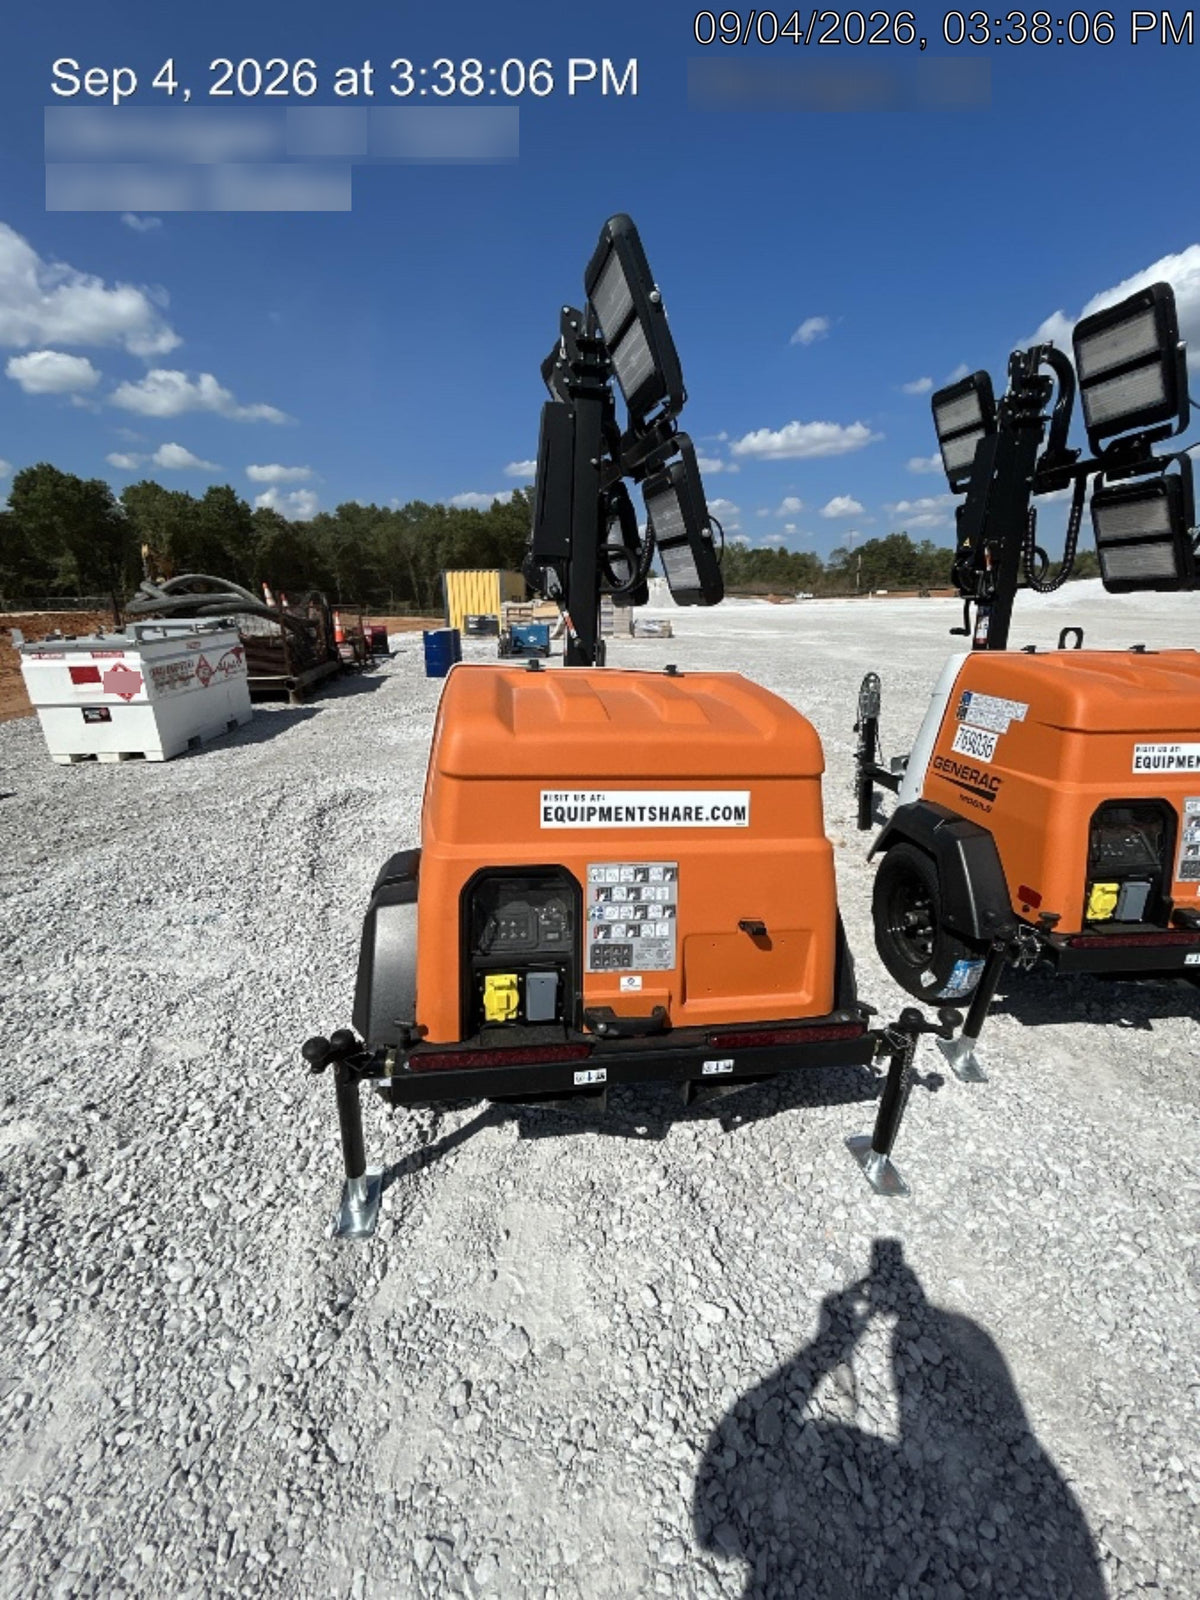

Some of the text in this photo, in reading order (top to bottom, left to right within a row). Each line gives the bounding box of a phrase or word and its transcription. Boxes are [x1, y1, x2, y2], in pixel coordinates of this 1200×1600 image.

[932, 755, 1004, 791] GENERAC
[543, 794, 569, 802] VISIT
[573, 794, 586, 802] US
[543, 805, 746, 823] EQUIPMENTSHARE.COM
